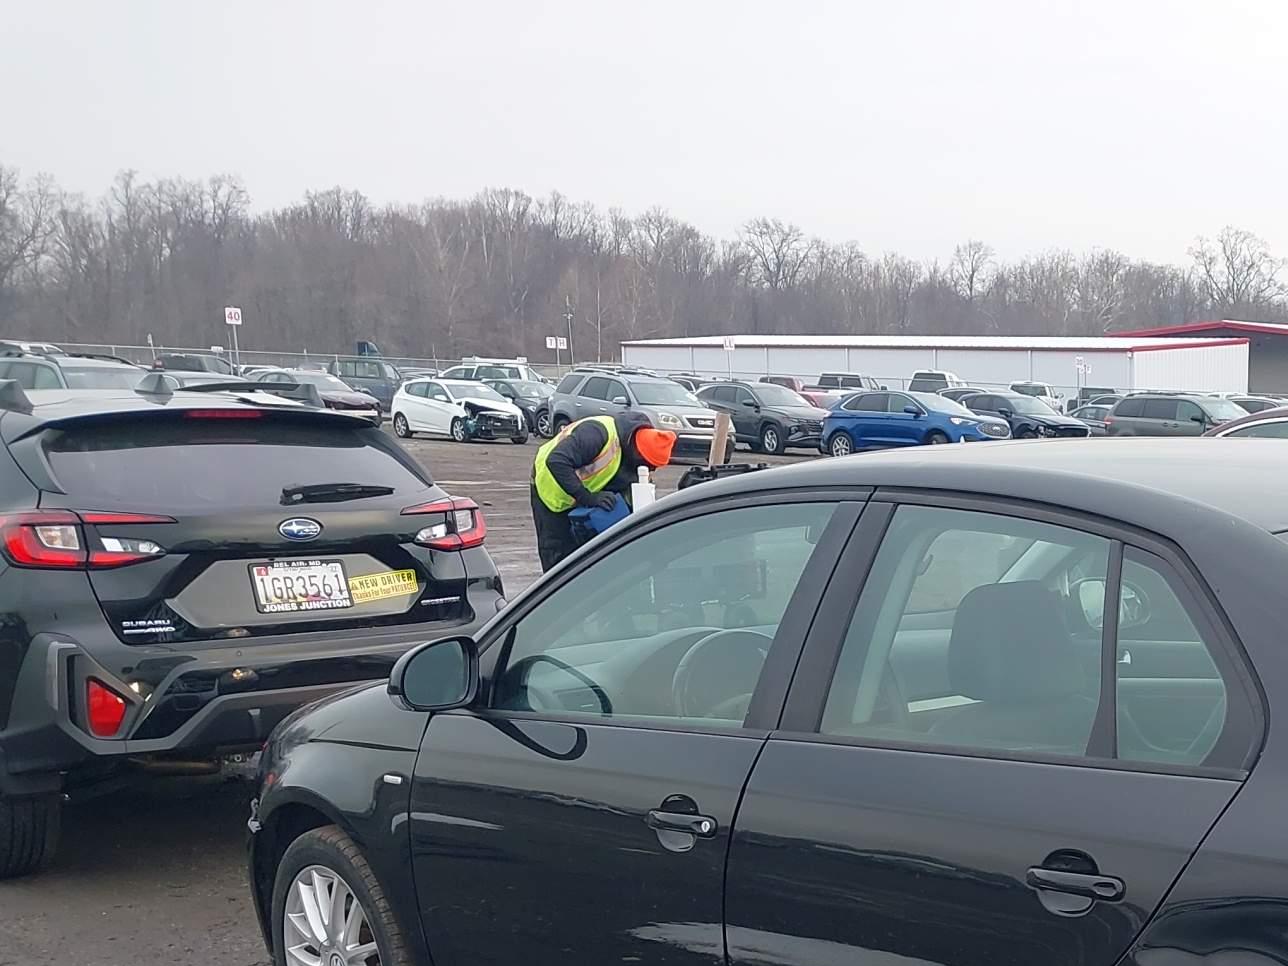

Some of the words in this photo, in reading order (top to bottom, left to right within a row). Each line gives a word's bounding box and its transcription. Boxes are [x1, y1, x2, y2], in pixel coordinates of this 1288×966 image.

[227, 312, 240, 321] 40
[260, 573, 344, 603] 1GR3561
[359, 578, 378, 590] NEW
[380, 572, 413, 586] DRIVER
[263, 603, 298, 613] JONES
[299, 599, 351, 610] JUNCTION
[122, 619, 171, 627] SUBARU
